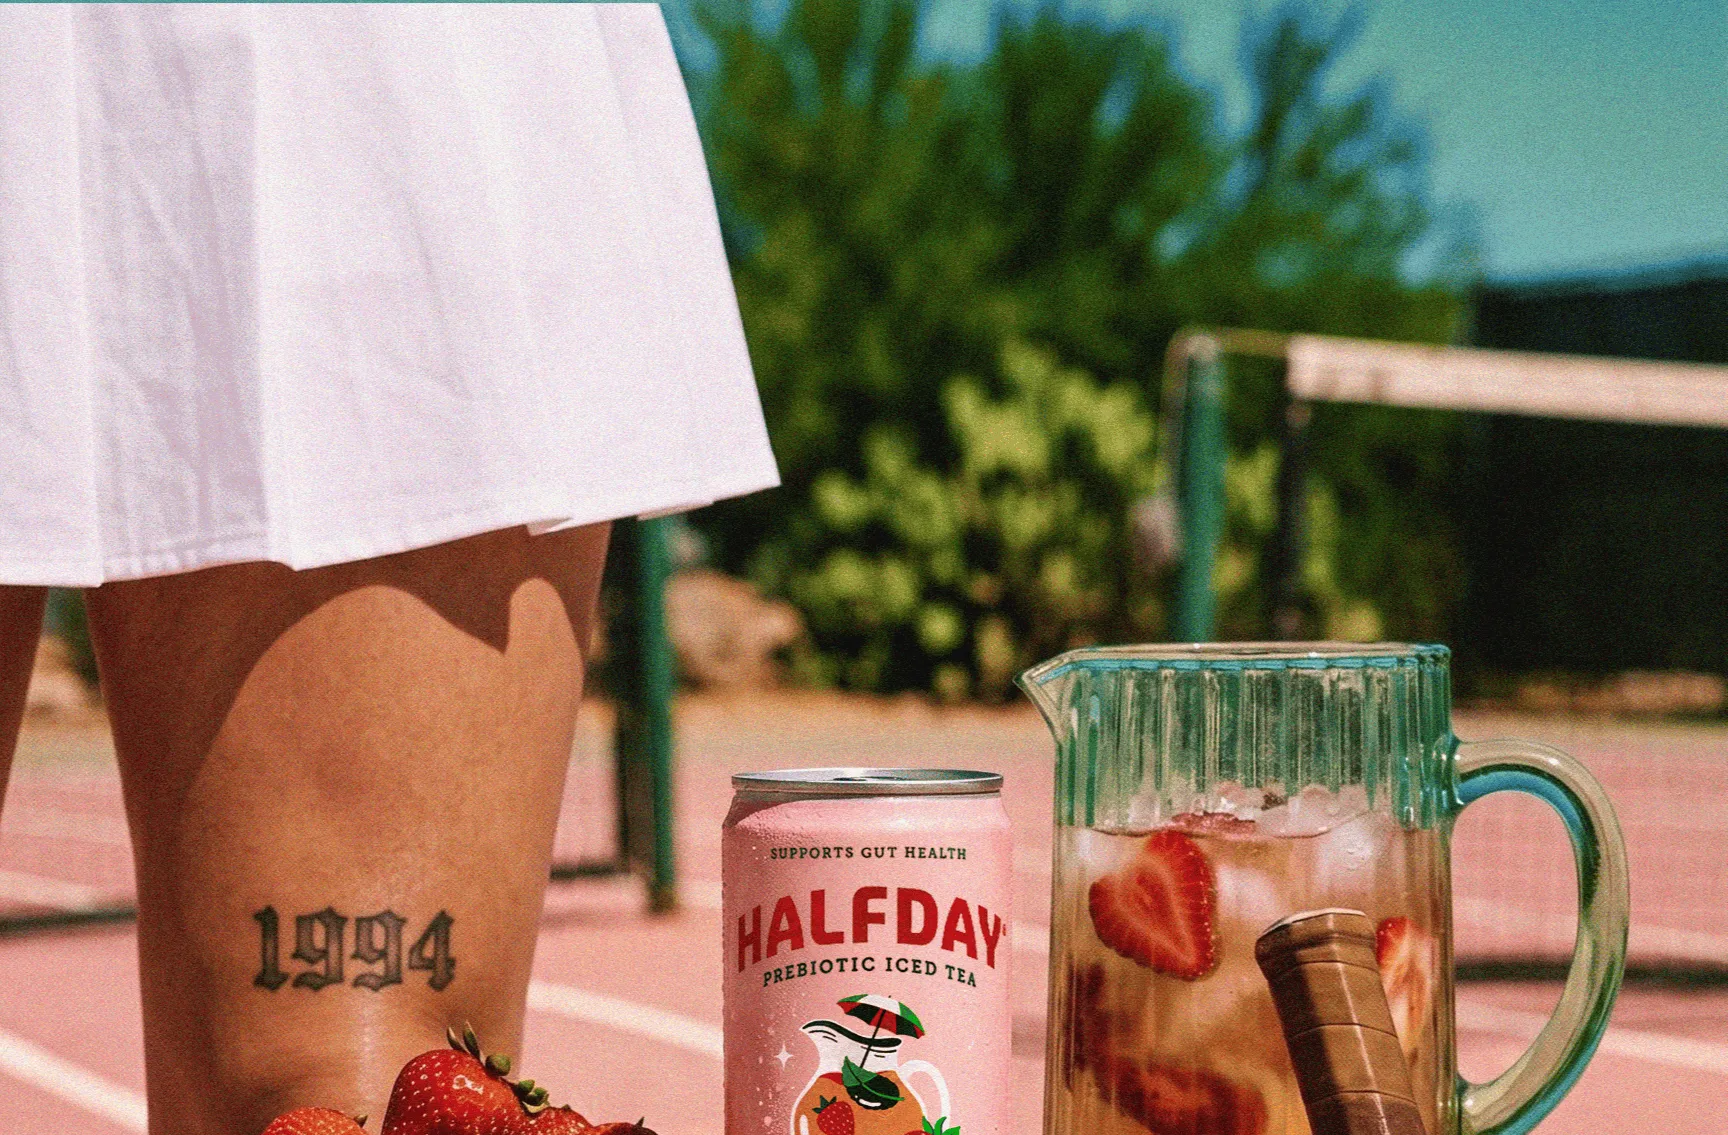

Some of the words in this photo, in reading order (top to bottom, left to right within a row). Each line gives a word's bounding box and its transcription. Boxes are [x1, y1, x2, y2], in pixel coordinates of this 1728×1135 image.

[770, 846, 854, 860] SUPPORTS
[861, 846, 898, 860] GUT
[905, 846, 967, 860] HEALTH
[253, 905, 456, 992] 1994
[738, 886, 1001, 973] HALFDAY
[763, 956, 876, 987] PREBIOTIC
[886, 957, 938, 976] ICED
[945, 964, 978, 988] TEA
